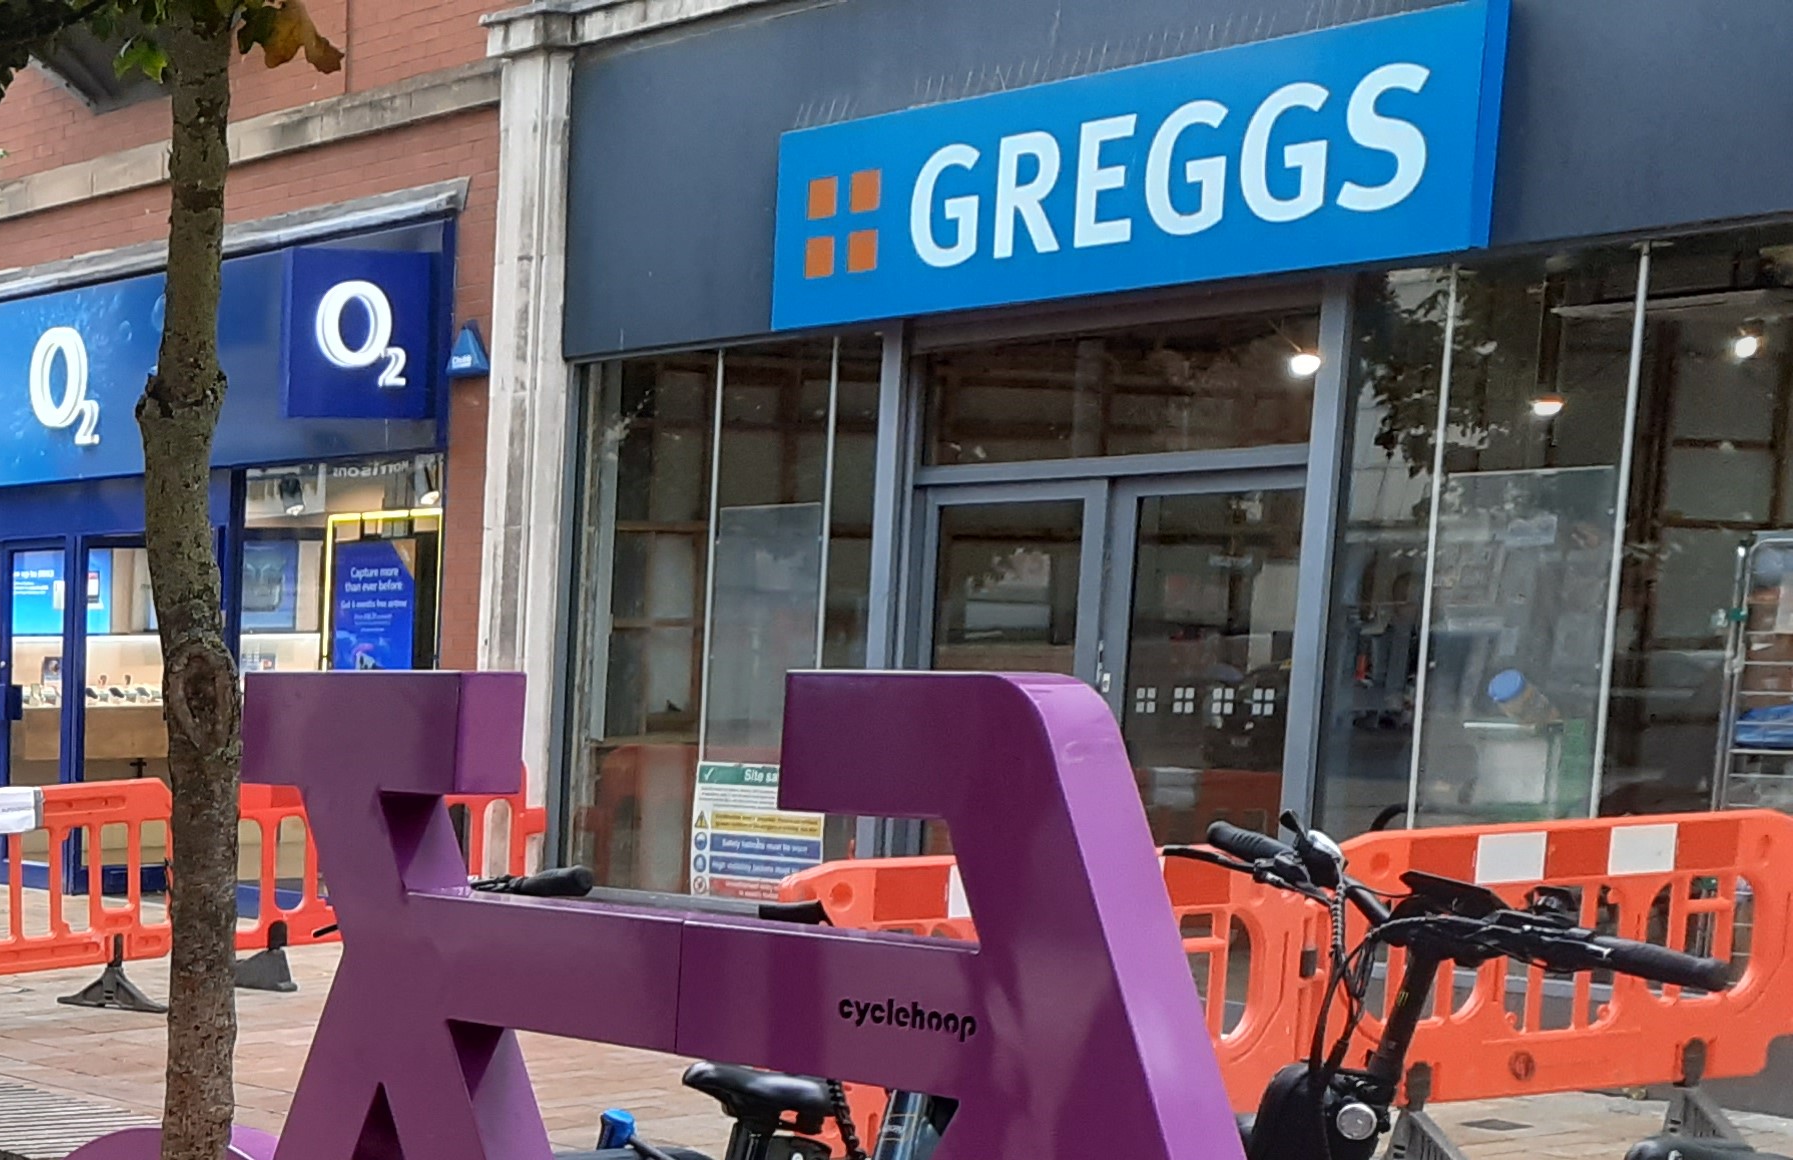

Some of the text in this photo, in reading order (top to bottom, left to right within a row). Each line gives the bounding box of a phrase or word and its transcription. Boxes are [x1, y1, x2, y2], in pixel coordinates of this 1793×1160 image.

[910, 62, 1431, 268] GREGGS
[316, 280, 407, 387] O2
[29, 326, 100, 445] O2
[345, 580, 403, 592] than ever before
[350, 567, 399, 580] Capture more
[744, 769, 764, 782] Site
[838, 998, 977, 1042] cyclehoop
